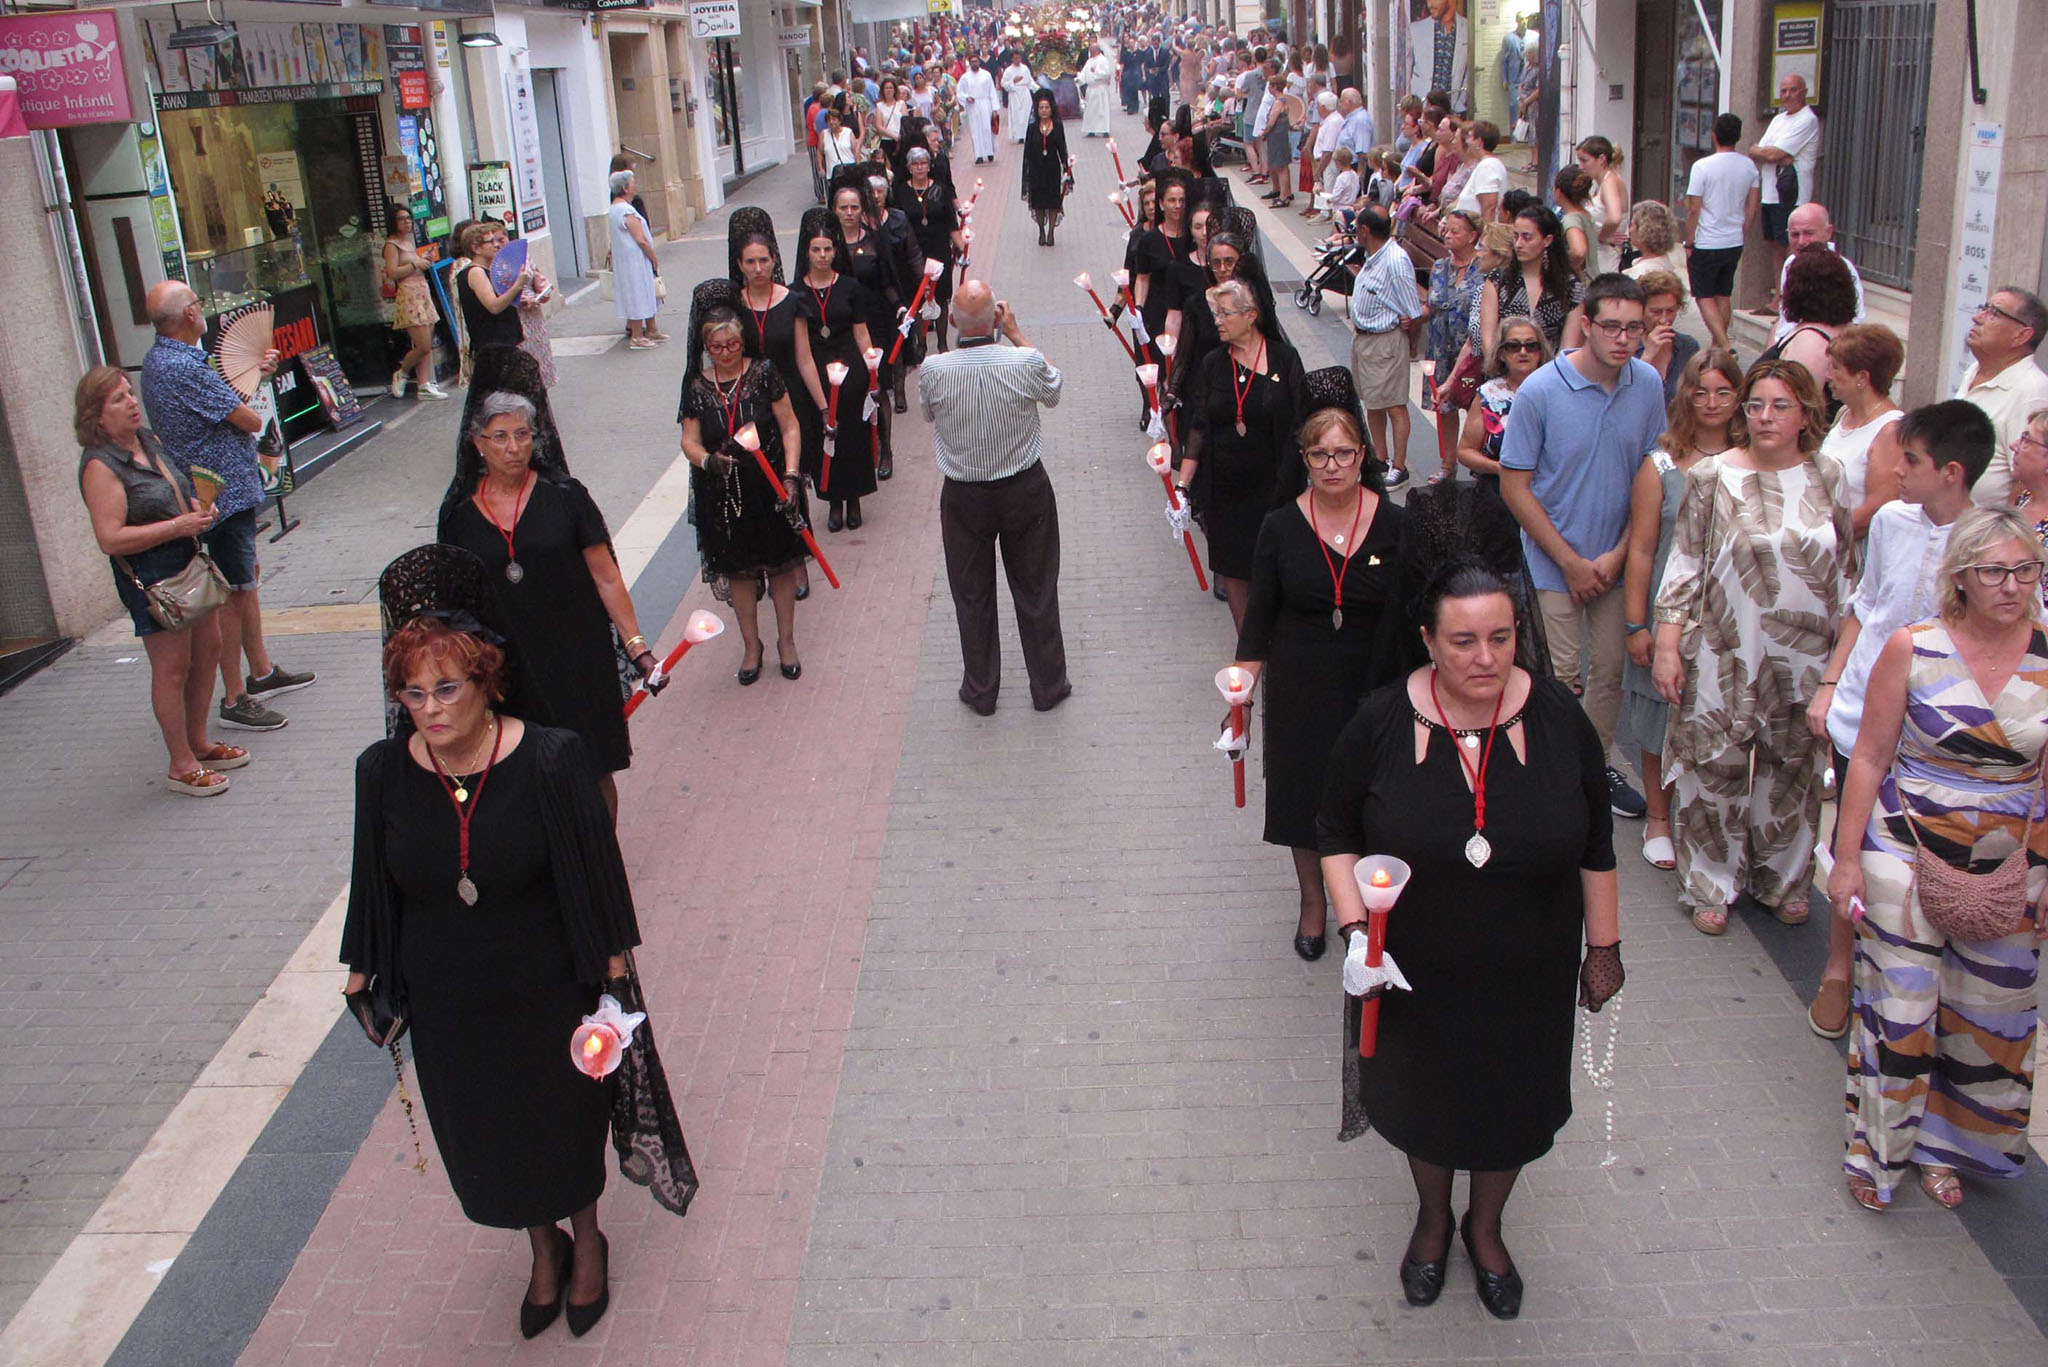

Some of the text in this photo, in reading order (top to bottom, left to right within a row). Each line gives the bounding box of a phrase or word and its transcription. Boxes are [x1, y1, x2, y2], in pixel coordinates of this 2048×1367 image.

[64, 92, 115, 110] Infantil
[477, 181, 504, 193] BLACK
[479, 194, 506, 206] HAWAII
[1965, 244, 1985, 260] BOSS
